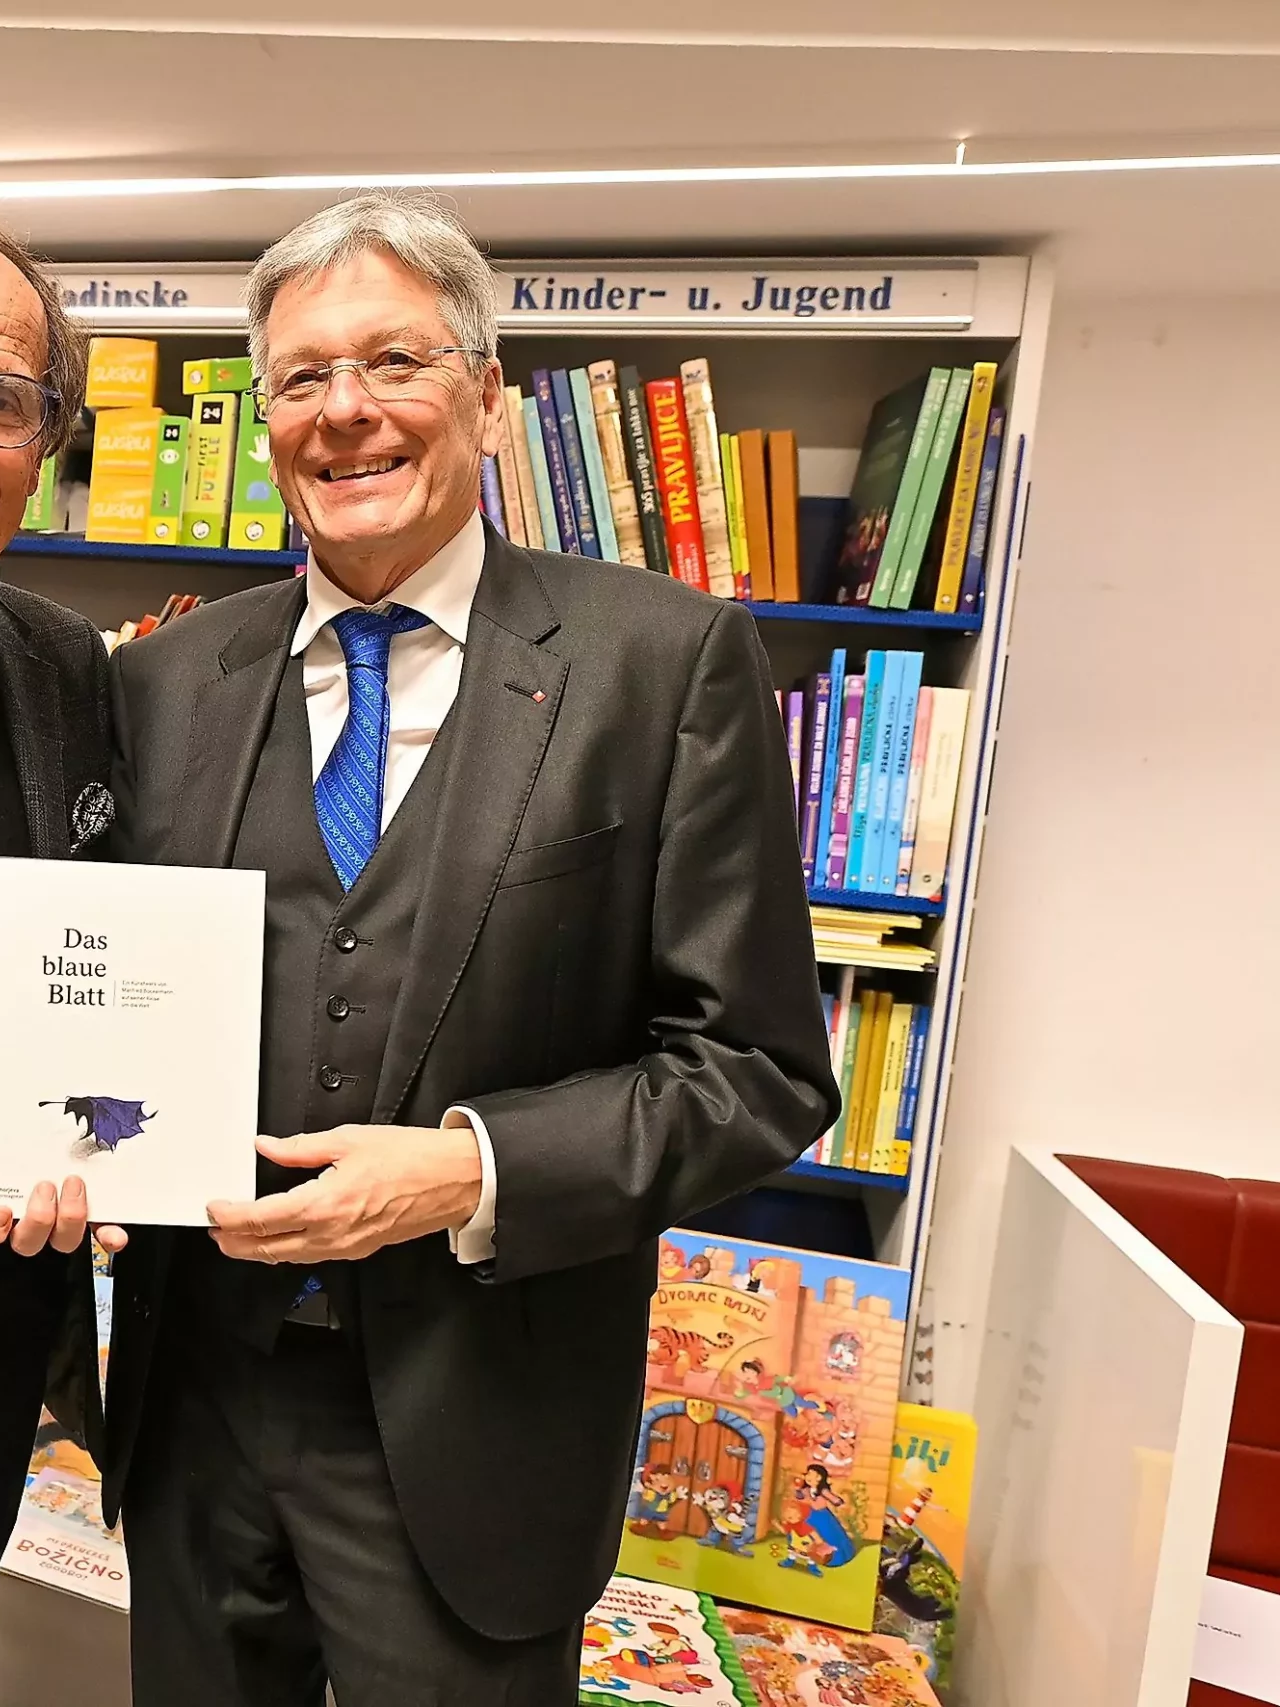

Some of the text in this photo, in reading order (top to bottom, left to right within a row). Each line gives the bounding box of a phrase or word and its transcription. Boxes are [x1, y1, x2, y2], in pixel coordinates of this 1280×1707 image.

[53, 280, 188, 307] adinske
[511, 276, 893, 317] Kinder- u. Jugend
[654, 386, 694, 526] PRAVLJICE
[63, 927, 109, 951] Das
[42, 955, 108, 978] blaue
[47, 982, 107, 1008] Blatt
[657, 1288, 717, 1305] DVORAC
[16, 1538, 124, 1581] BOŽIČNO
